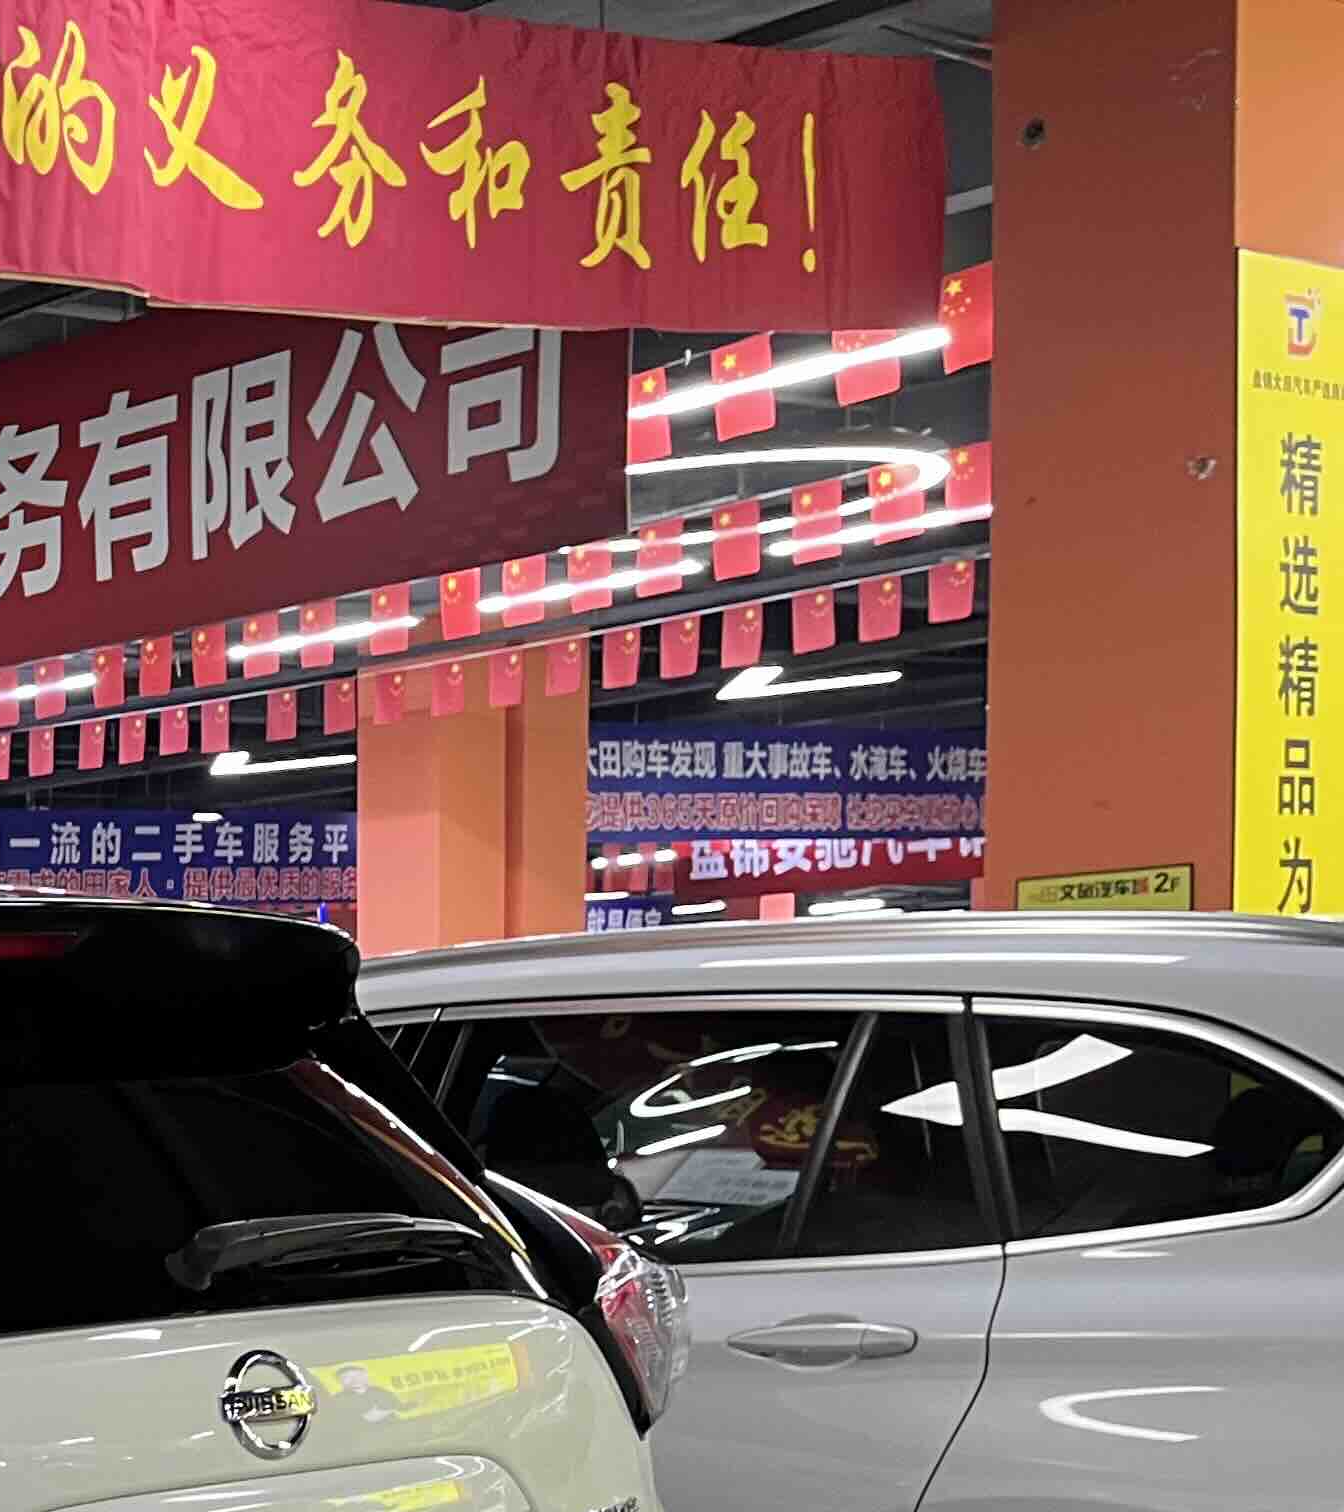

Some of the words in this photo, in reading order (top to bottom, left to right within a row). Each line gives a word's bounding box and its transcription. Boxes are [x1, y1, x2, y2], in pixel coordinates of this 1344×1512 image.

[1276, 431, 1321, 914] 精选精品为
